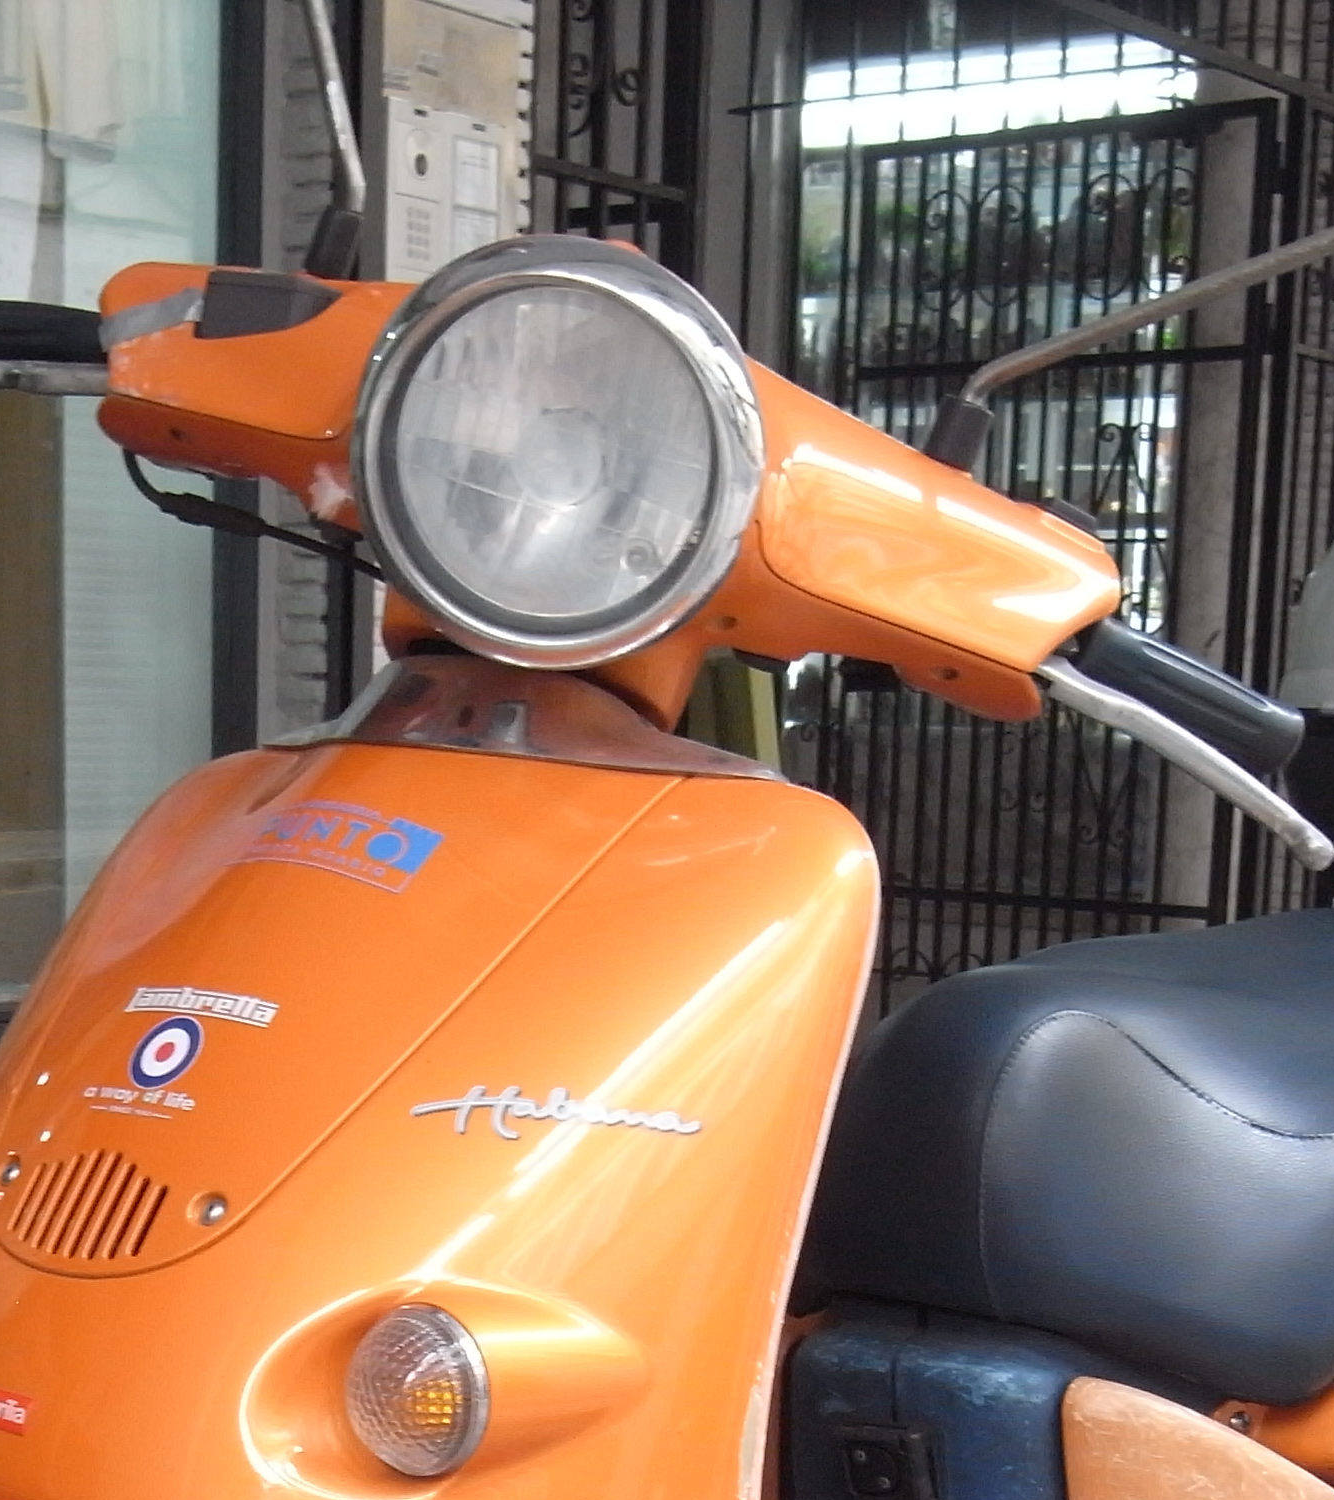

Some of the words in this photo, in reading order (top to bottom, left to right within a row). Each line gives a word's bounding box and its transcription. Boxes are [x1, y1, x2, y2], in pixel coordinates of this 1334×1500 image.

[100, 1087, 139, 1103] way
[142, 1089, 164, 1104] of
[162, 1092, 196, 1111] life
[410, 1085, 703, 1140] Habana
